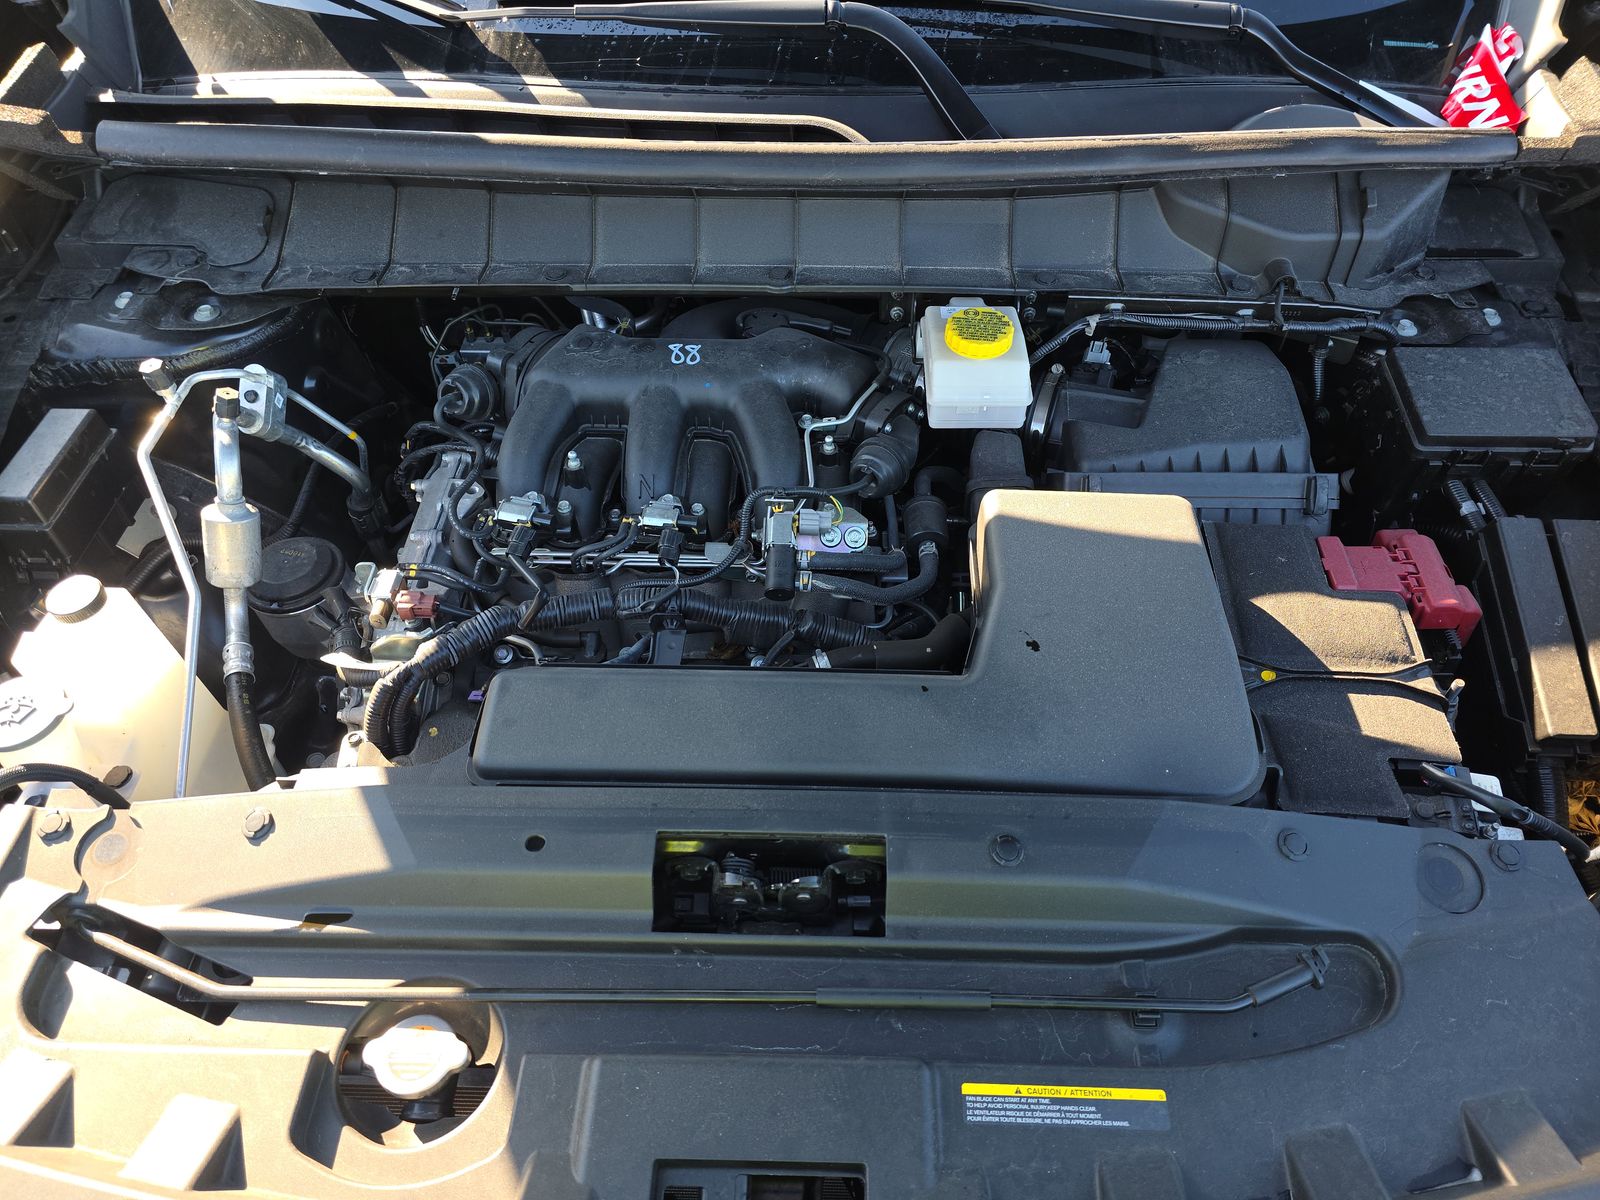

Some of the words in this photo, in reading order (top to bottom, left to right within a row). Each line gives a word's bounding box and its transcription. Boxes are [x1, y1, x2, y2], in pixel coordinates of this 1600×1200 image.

[668, 343, 702, 365] 88
[638, 473, 655, 499] N
[1027, 1087, 1061, 1096] CAUTION
[1070, 1089, 1112, 1097] ATTENTION
